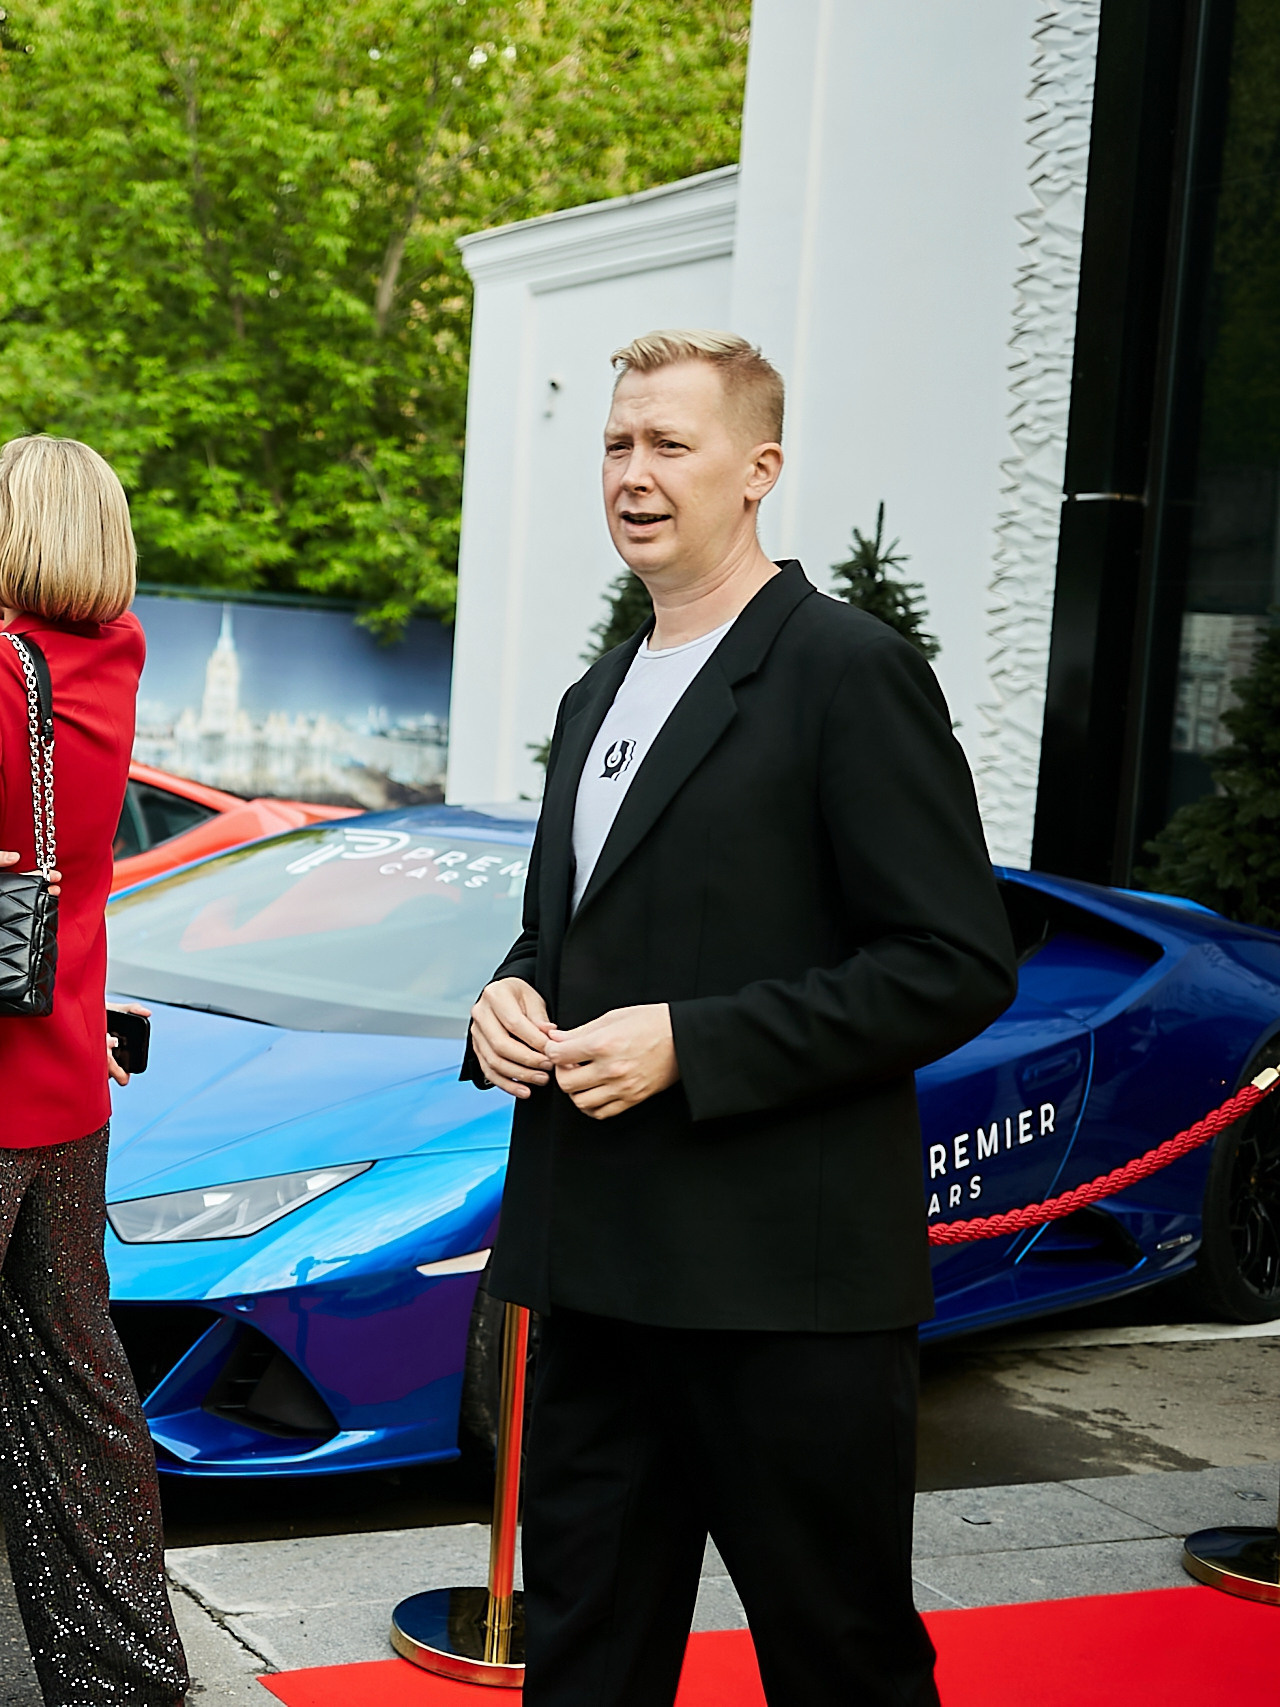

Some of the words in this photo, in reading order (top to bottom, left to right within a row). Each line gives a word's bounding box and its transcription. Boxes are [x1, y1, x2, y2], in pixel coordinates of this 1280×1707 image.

[379, 862, 488, 888] CARS
[401, 847, 528, 878] PREM
[929, 1102, 1055, 1179] REMIER
[927, 1174, 982, 1217] ARS
